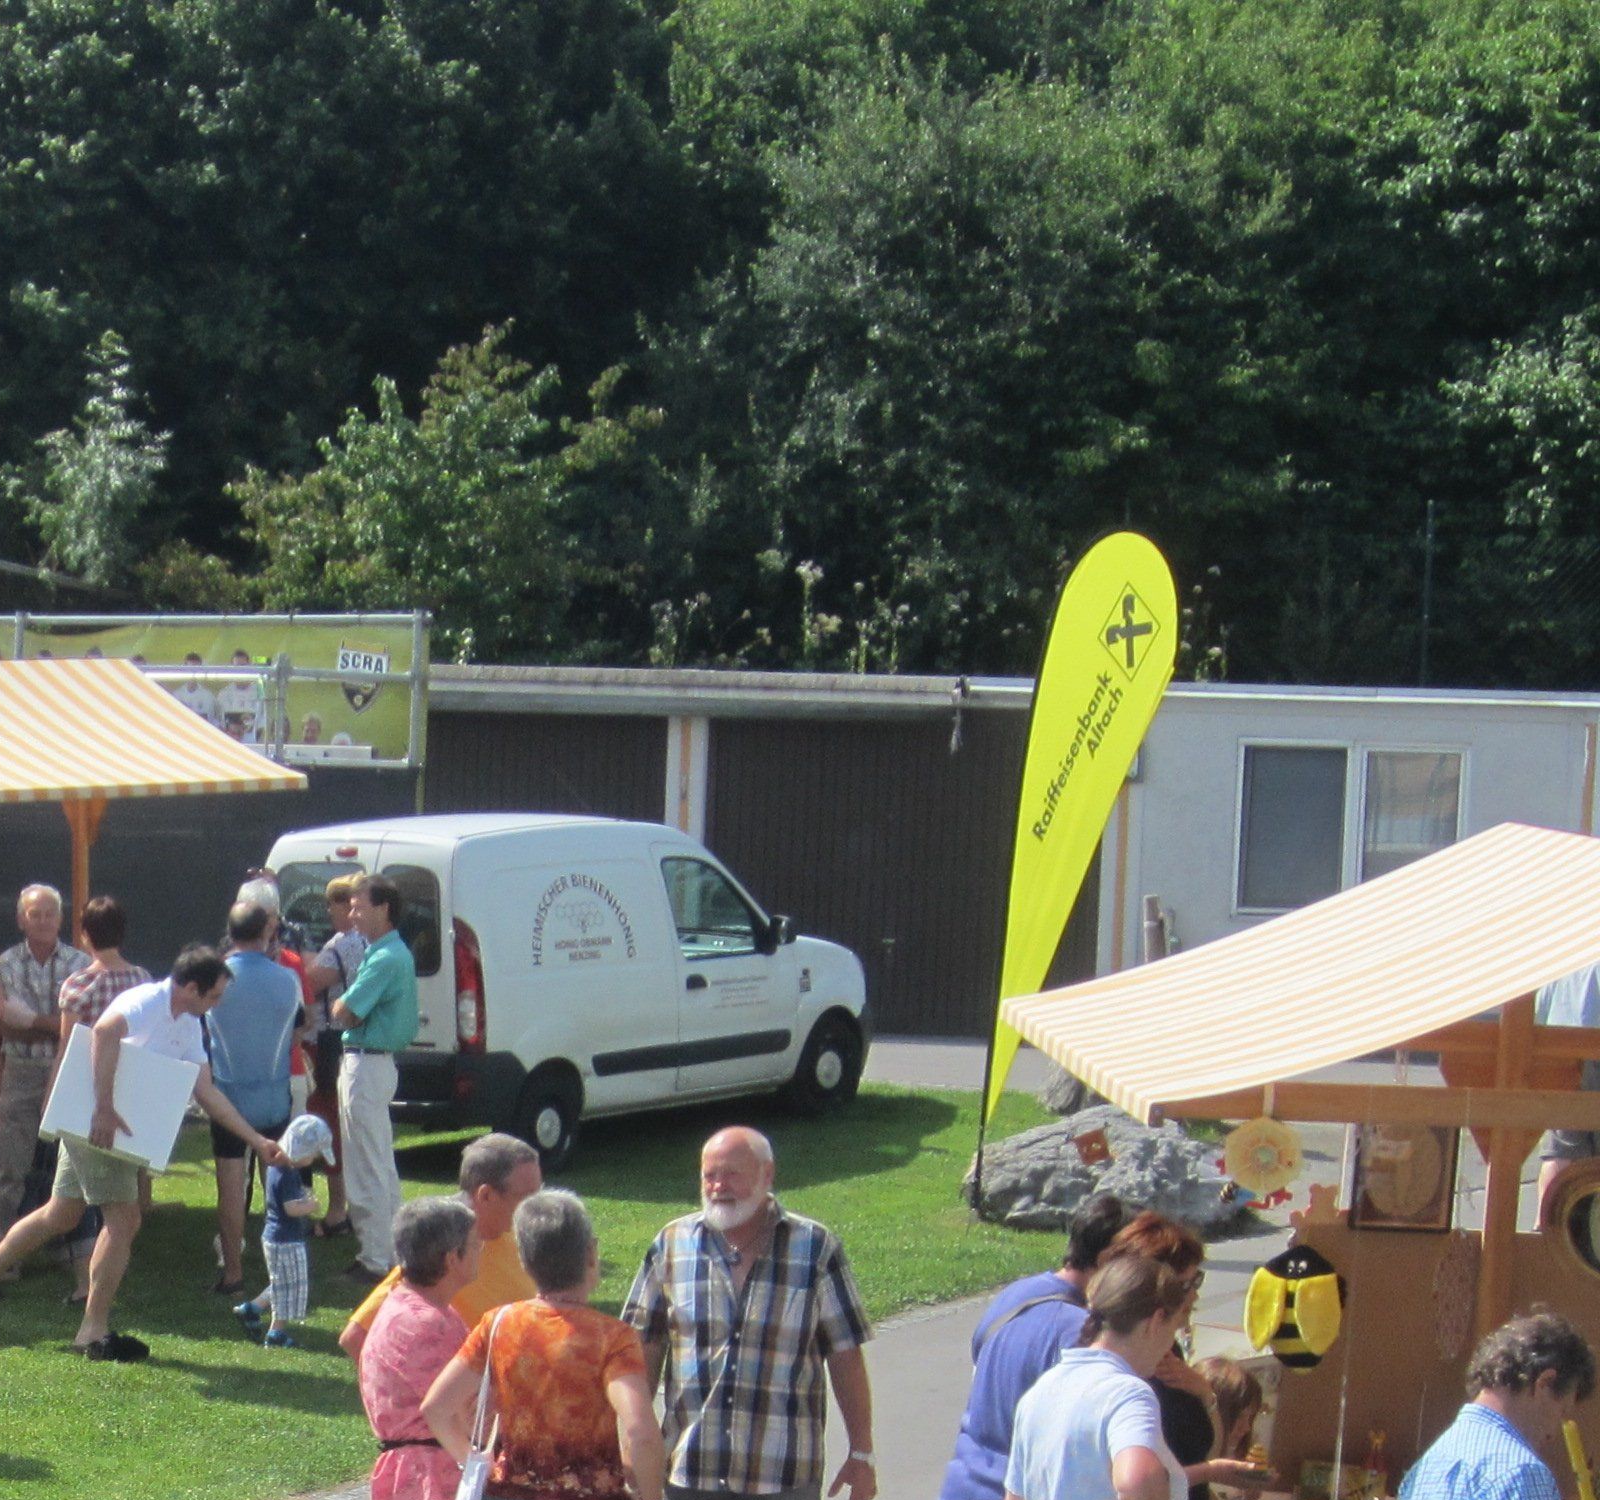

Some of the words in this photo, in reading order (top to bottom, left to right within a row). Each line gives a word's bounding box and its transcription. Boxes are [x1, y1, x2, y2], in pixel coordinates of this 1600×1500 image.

[340, 652, 385, 674] SCRA
[1032, 670, 1112, 842] Raiffeisenbank
[1086, 687, 1123, 760] Altach
[531, 875, 568, 966] HEIMISCHER
